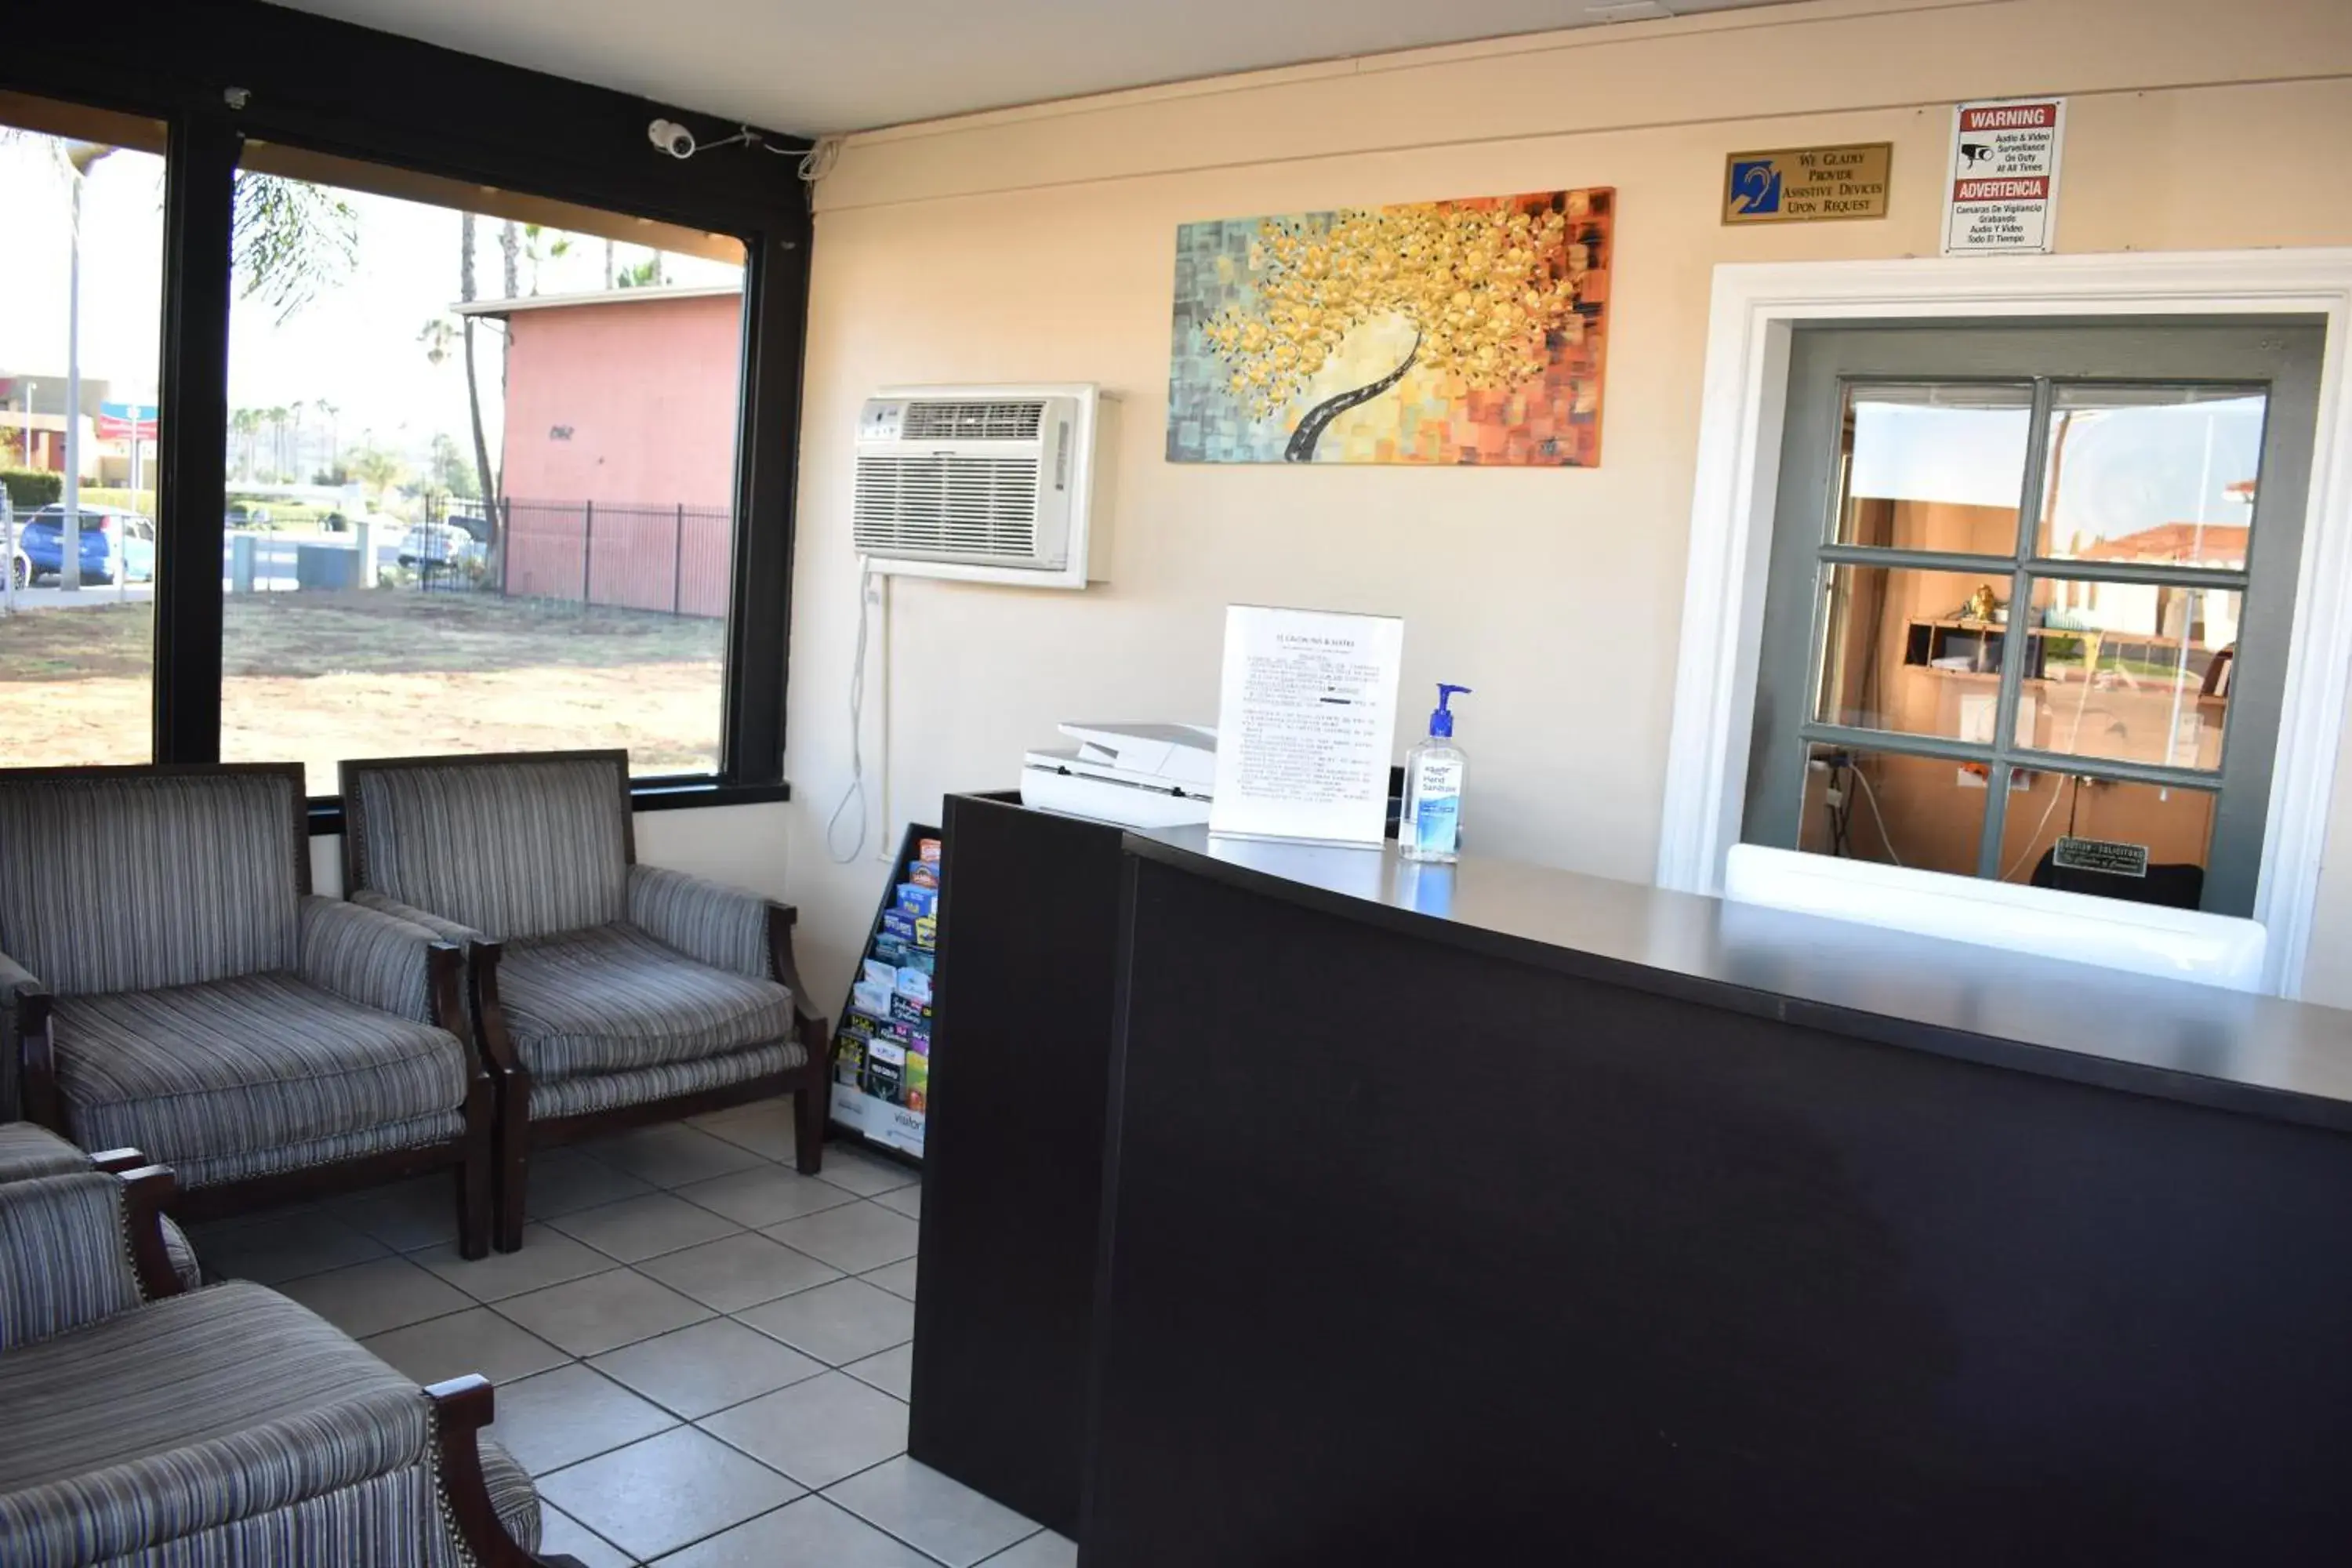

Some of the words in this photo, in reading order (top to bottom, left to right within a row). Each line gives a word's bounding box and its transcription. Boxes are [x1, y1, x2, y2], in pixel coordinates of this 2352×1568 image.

[1970, 108, 2045, 128] WARNING
[1995, 133, 2018, 143] Audio
[2028, 132, 2050, 141] Video
[1823, 152, 1864, 165] GLADLY
[1809, 169, 1854, 181] PROVIDE
[1783, 187, 1832, 199] ASSISTIVE
[1838, 183, 1882, 196] DEVICES
[1959, 180, 2042, 198] ADVERTENCIA
[1788, 200, 1817, 214] UPON
[1823, 198, 1870, 212] REQUEST
